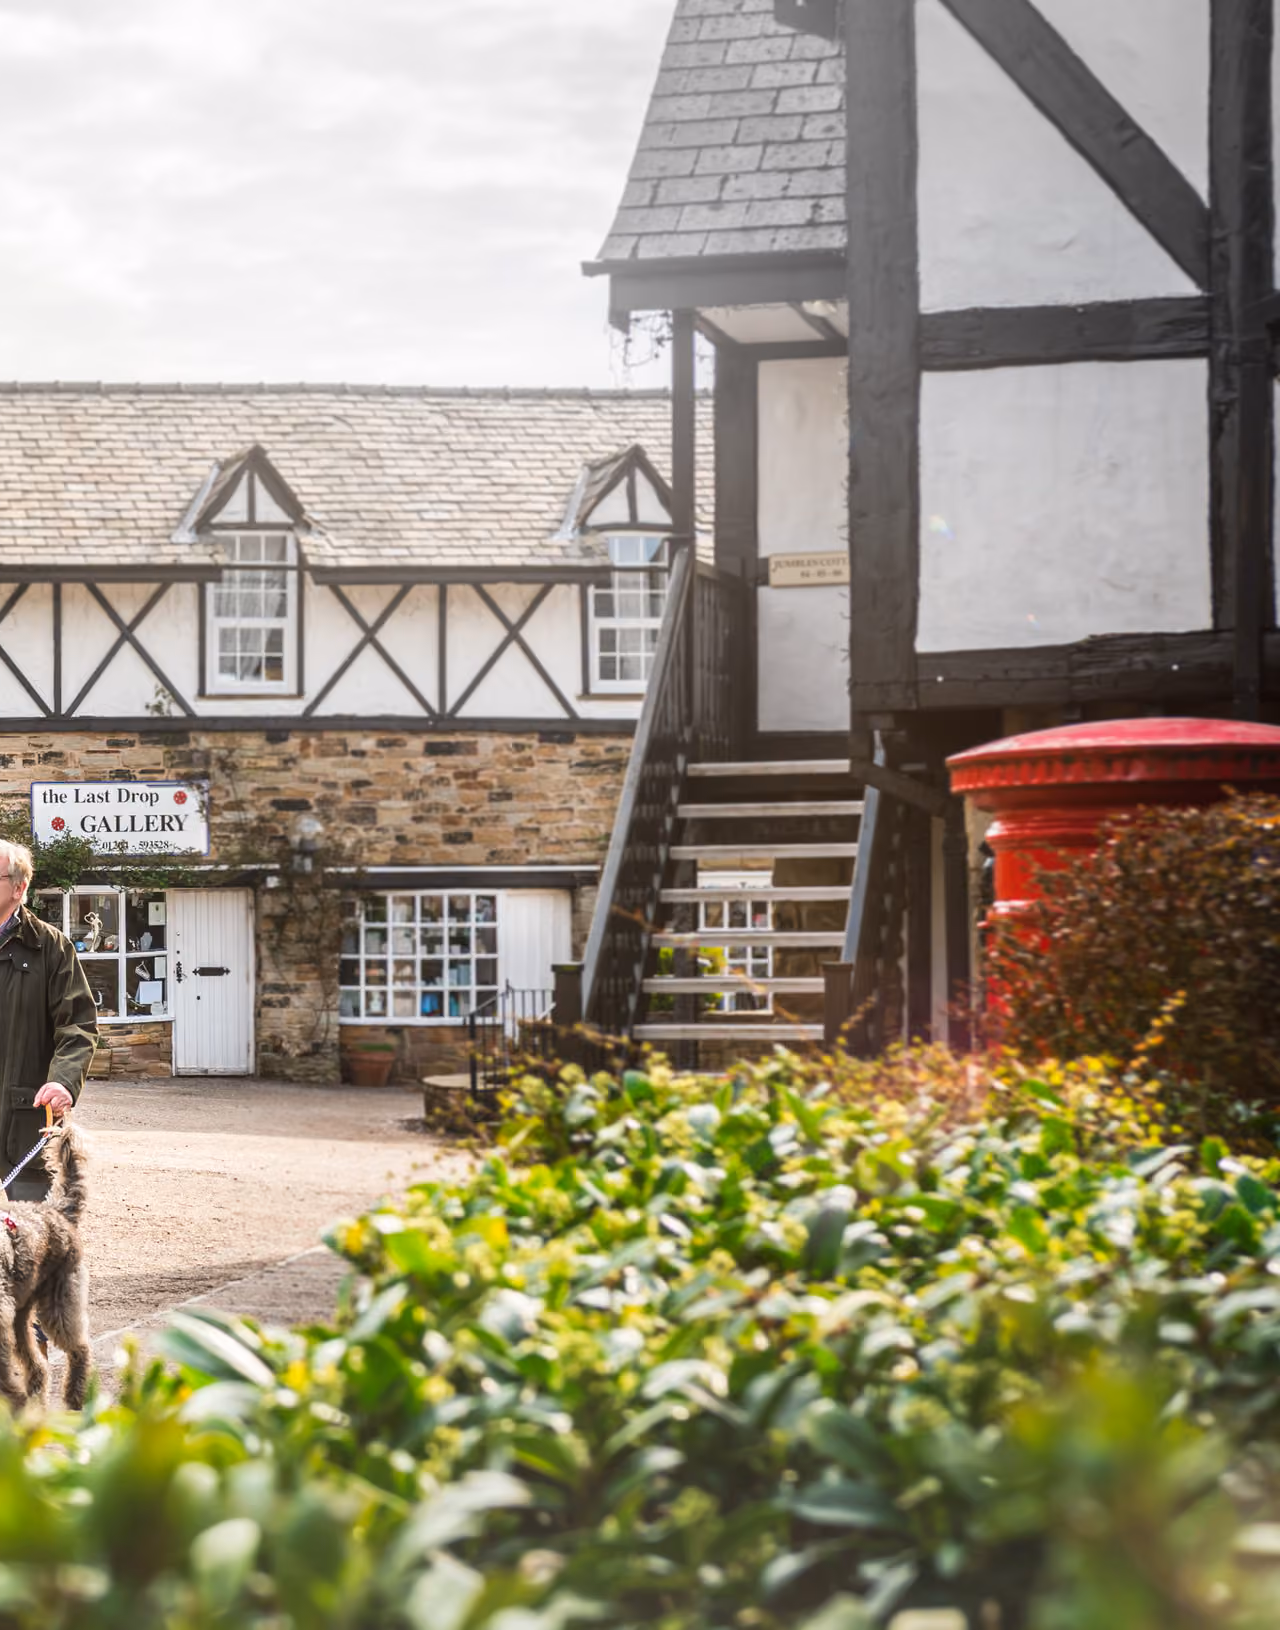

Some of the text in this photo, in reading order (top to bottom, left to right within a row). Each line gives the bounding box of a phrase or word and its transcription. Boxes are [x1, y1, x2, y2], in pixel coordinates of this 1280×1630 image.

[820, 557, 848, 567] COTT
[42, 788, 160, 806] the Last Drop
[80, 815, 188, 833] GALLERY
[138, 840, 170, 850] 593528
